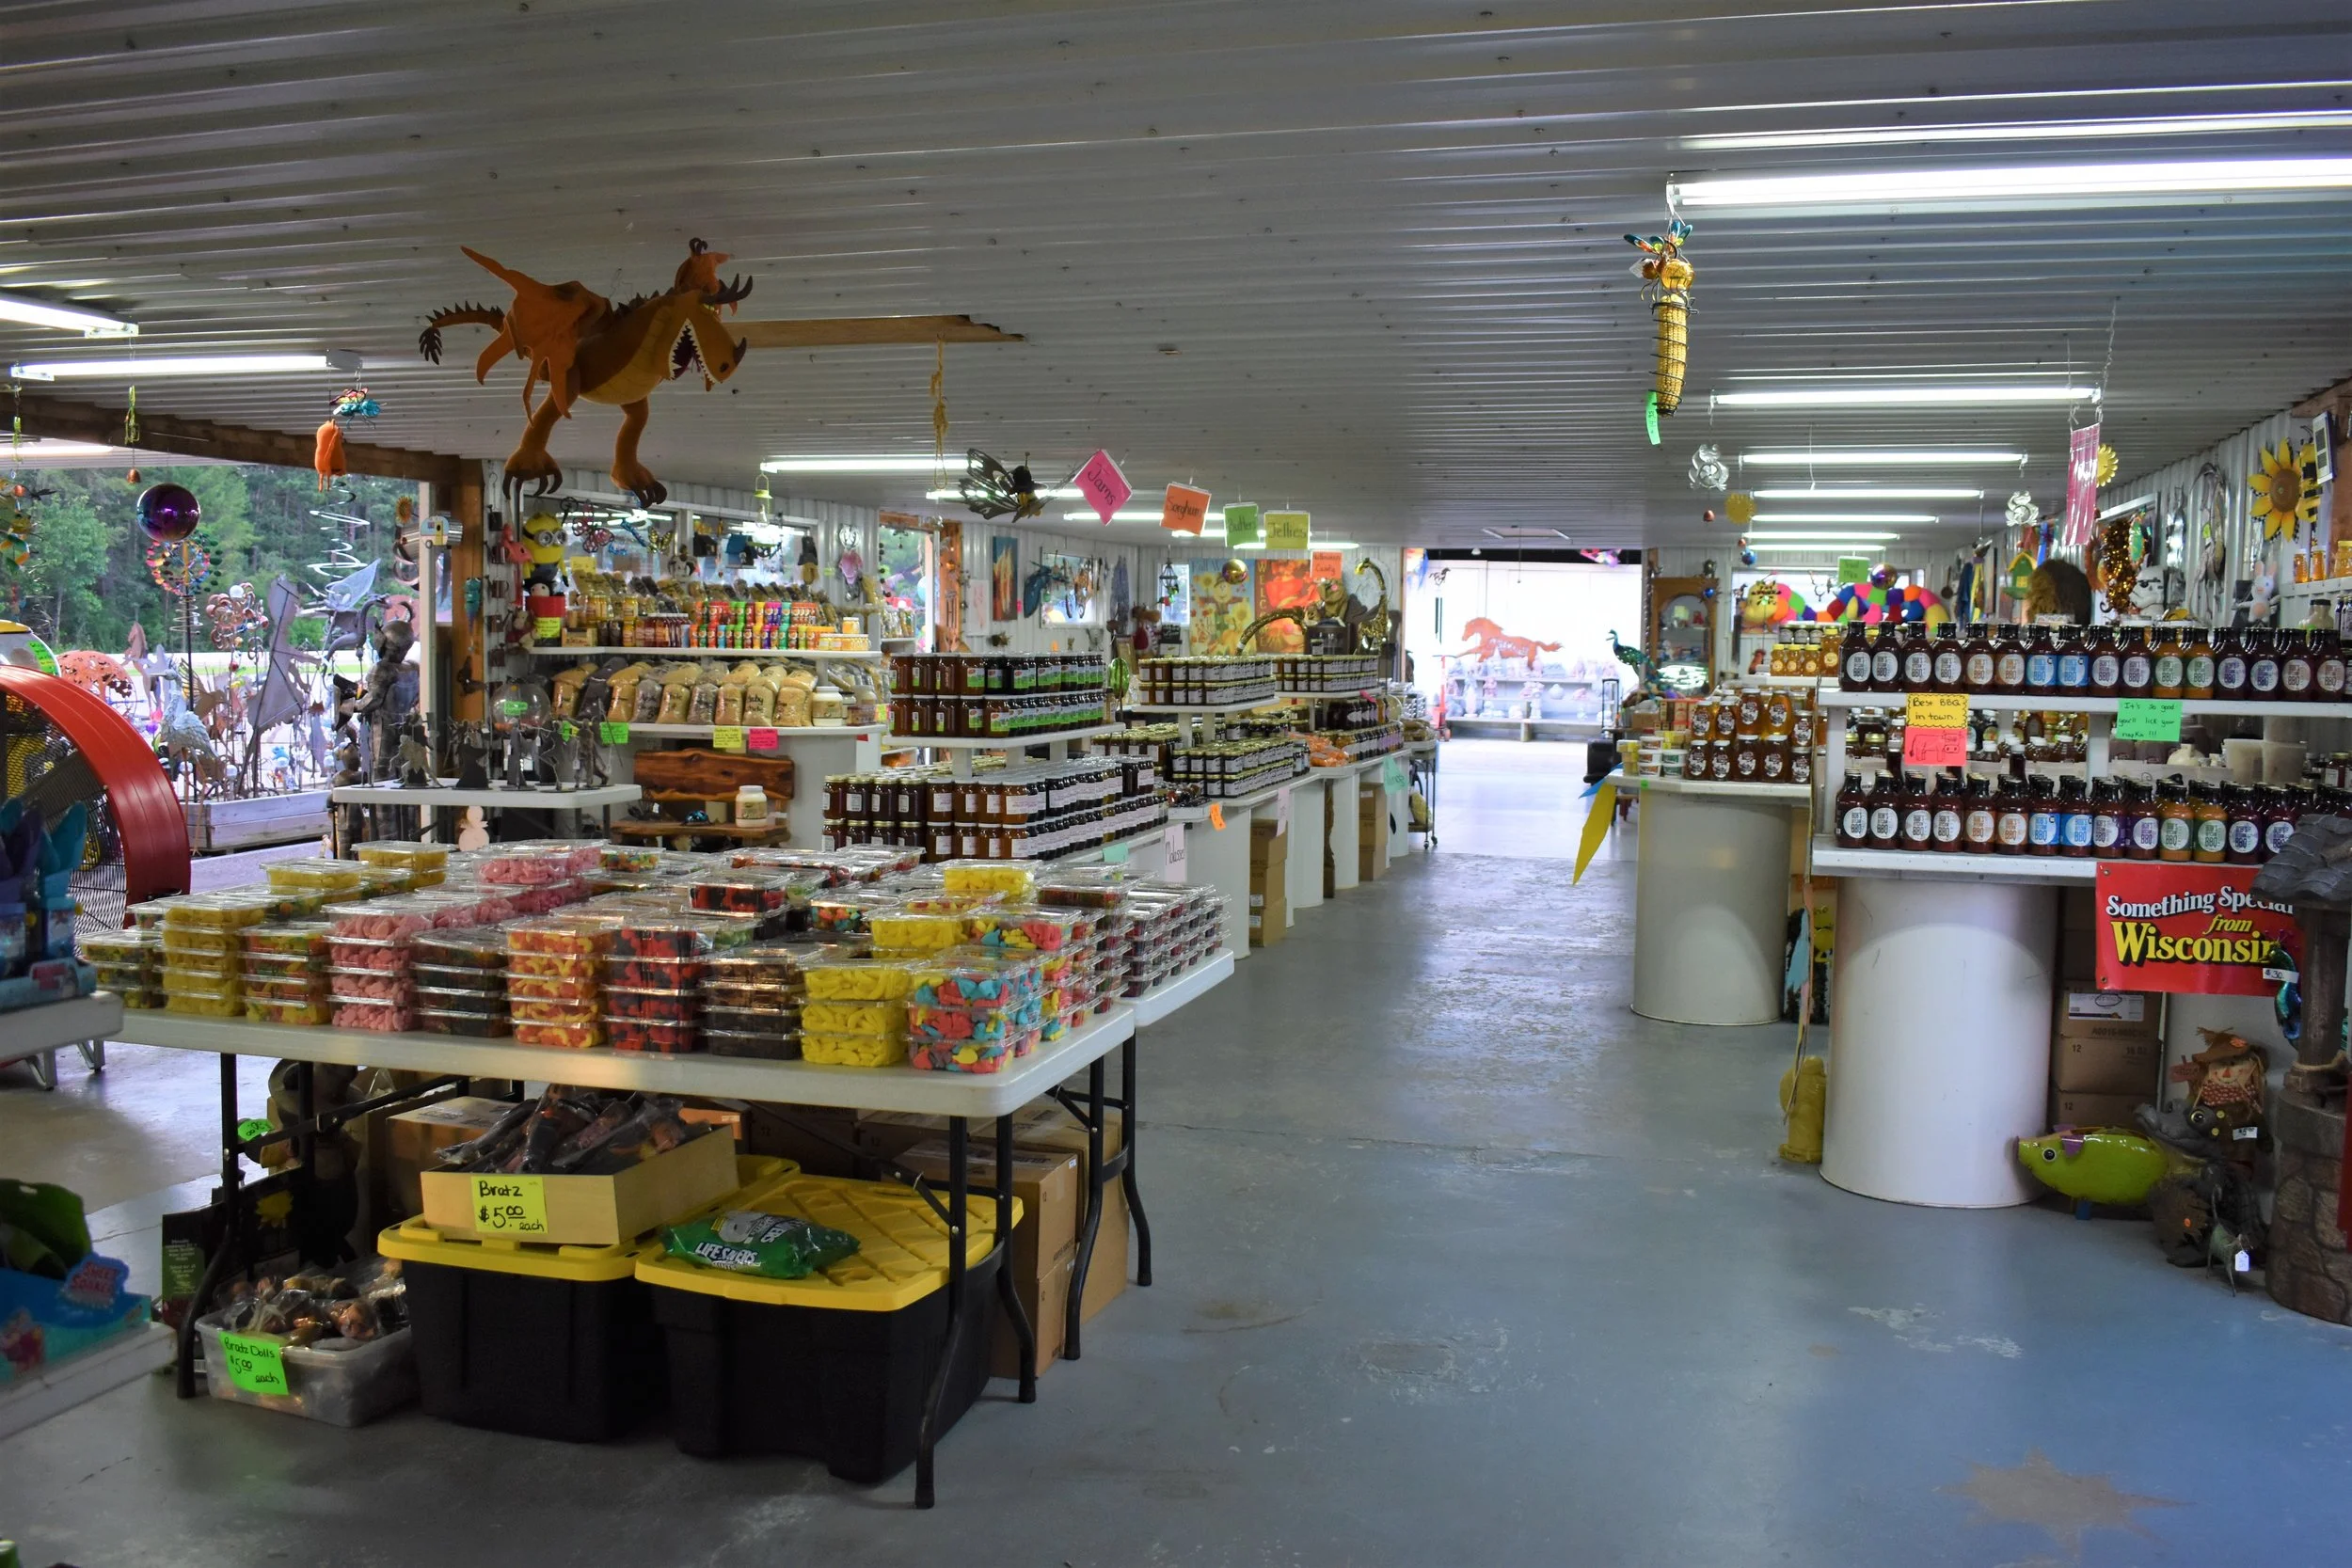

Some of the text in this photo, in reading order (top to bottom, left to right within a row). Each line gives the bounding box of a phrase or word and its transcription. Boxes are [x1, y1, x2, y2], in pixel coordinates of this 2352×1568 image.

[1088, 462, 1117, 506] Jams
[1267, 522, 1307, 539] Jellies
[1913, 697, 1932, 706] Best
[1915, 711, 1925, 720] in
[1851, 824, 1862, 834] BBQ
[1877, 824, 1889, 835] BBQ
[1913, 826, 1924, 837] BBQ
[1938, 828, 1949, 838] BBQ
[1972, 828, 1984, 838] BBQ
[2005, 830, 2017, 841] BBQ
[2035, 830, 2047, 842] BBQ
[2074, 832, 2087, 843] BBQ
[2095, 832, 2106, 843] BBQ
[2141, 834, 2153, 845] BBQ
[2166, 834, 2177, 847] BBQ
[2205, 837, 2217, 847] BBQ
[2235, 837, 2248, 847] BBQ
[2106, 891, 2217, 918] Something
[2202, 913, 2252, 935] from
[2073, 1044, 2082, 1053] 12
[478, 1180, 523, 1197] Bratz
[519, 1218, 545, 1232] each
[224, 1337, 276, 1357] Bratz Dolls
[255, 1371, 280, 1385] each
